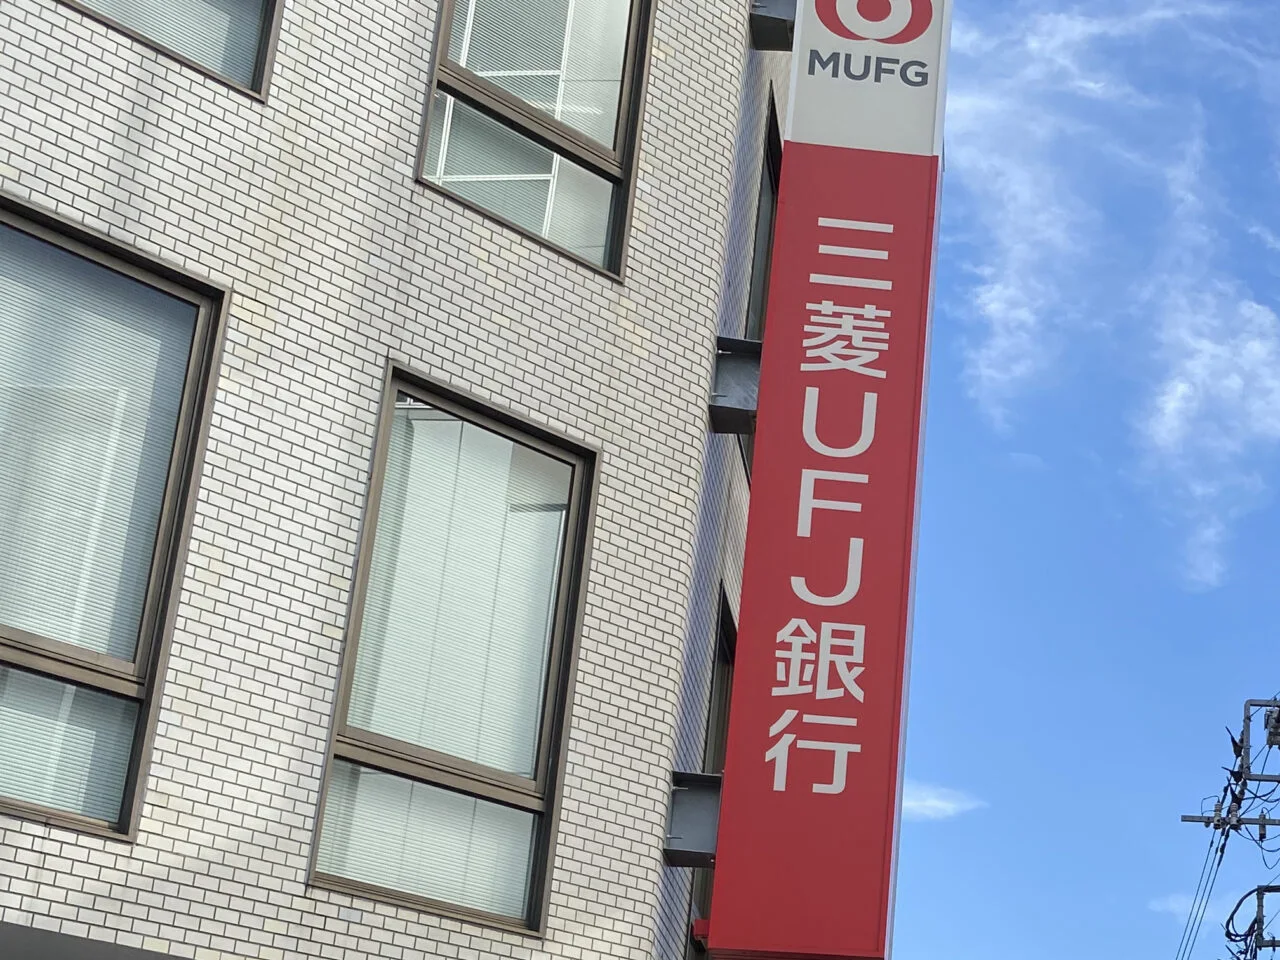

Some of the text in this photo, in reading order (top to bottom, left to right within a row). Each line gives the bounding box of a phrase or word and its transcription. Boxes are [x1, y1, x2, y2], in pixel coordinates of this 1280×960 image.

[808, 50, 929, 87] MUFG
[764, 216, 895, 796] 三菱UFJ銀行
